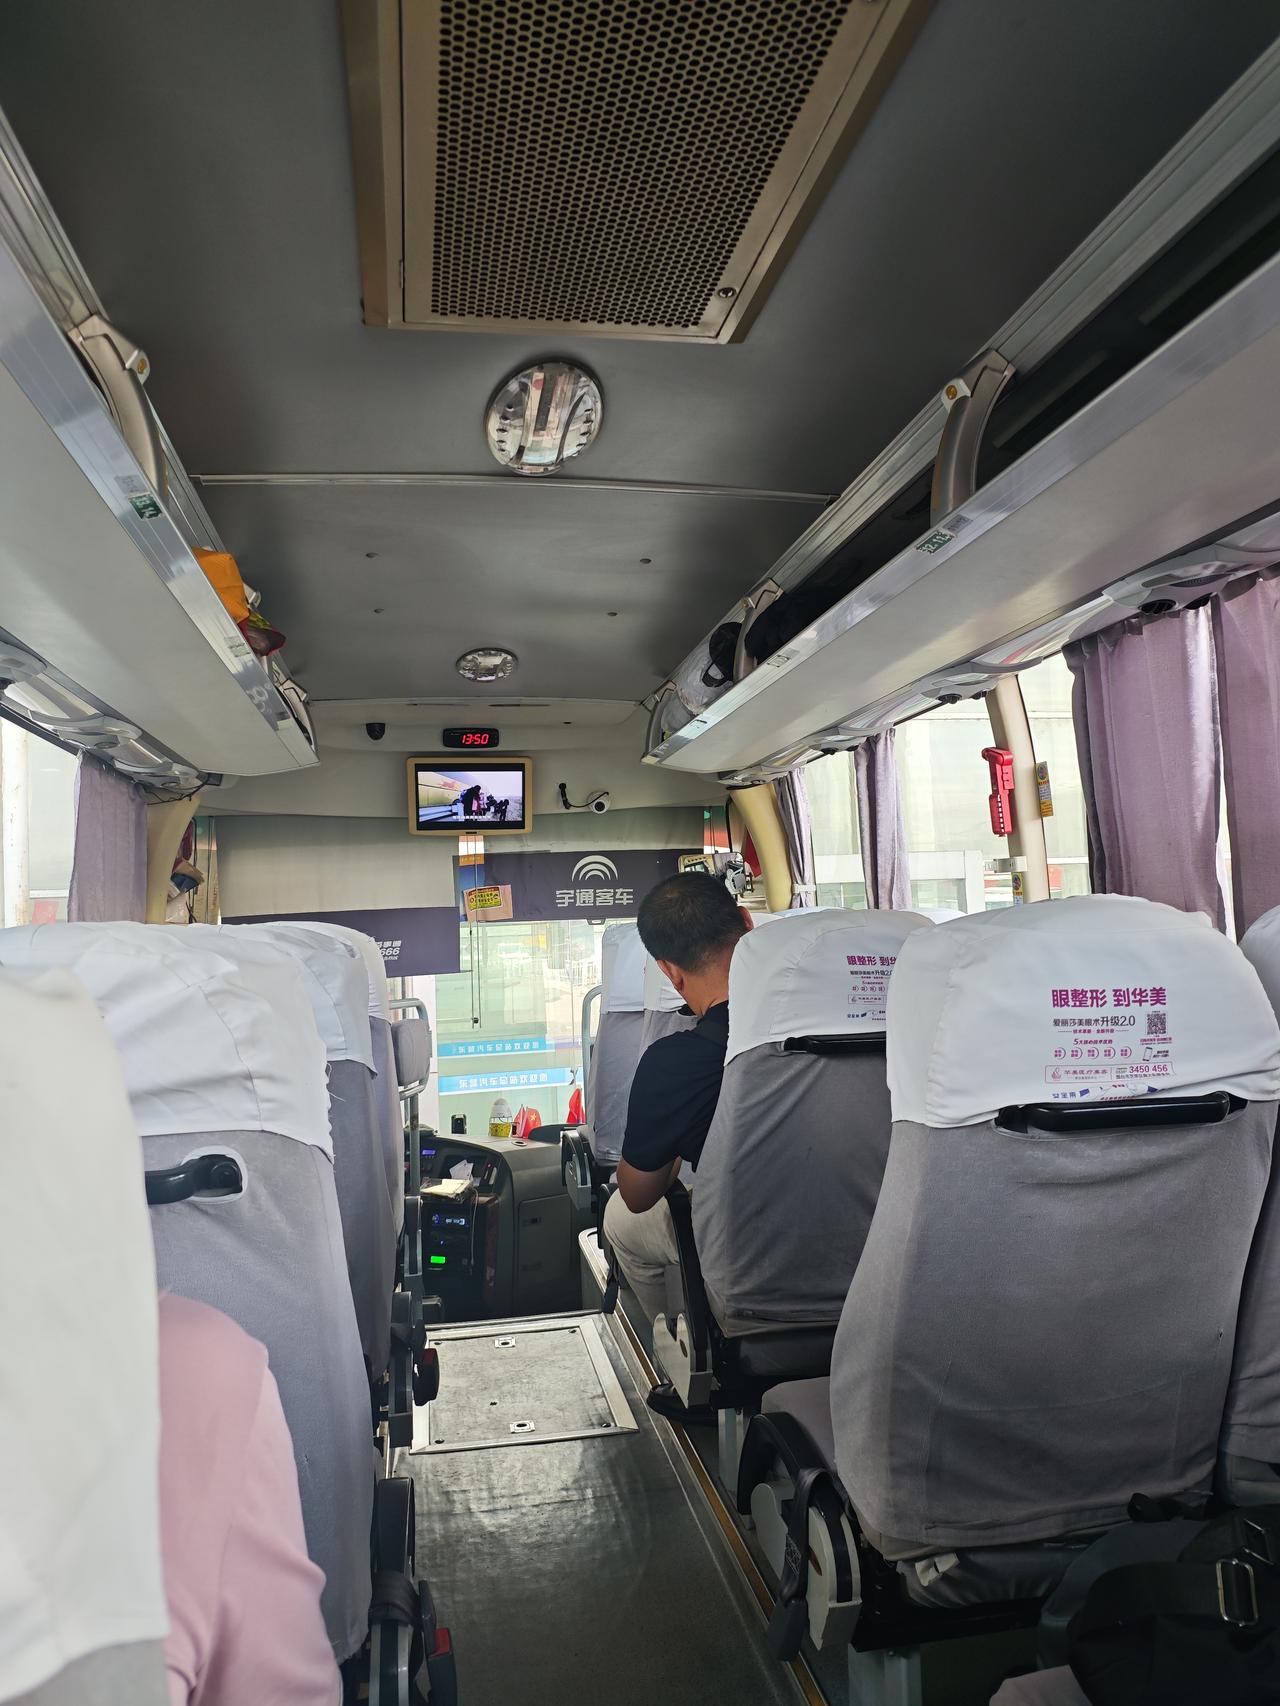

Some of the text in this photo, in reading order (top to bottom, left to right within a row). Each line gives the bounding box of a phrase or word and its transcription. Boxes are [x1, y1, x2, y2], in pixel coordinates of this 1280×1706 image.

[462, 733, 489, 745] 13:50
[555, 888, 634, 907] 宇通客车
[1051, 986, 1167, 1009] 眼整形 到华美
[1129, 1065, 1149, 1073] 3450
[1152, 1064, 1168, 1073] 456
